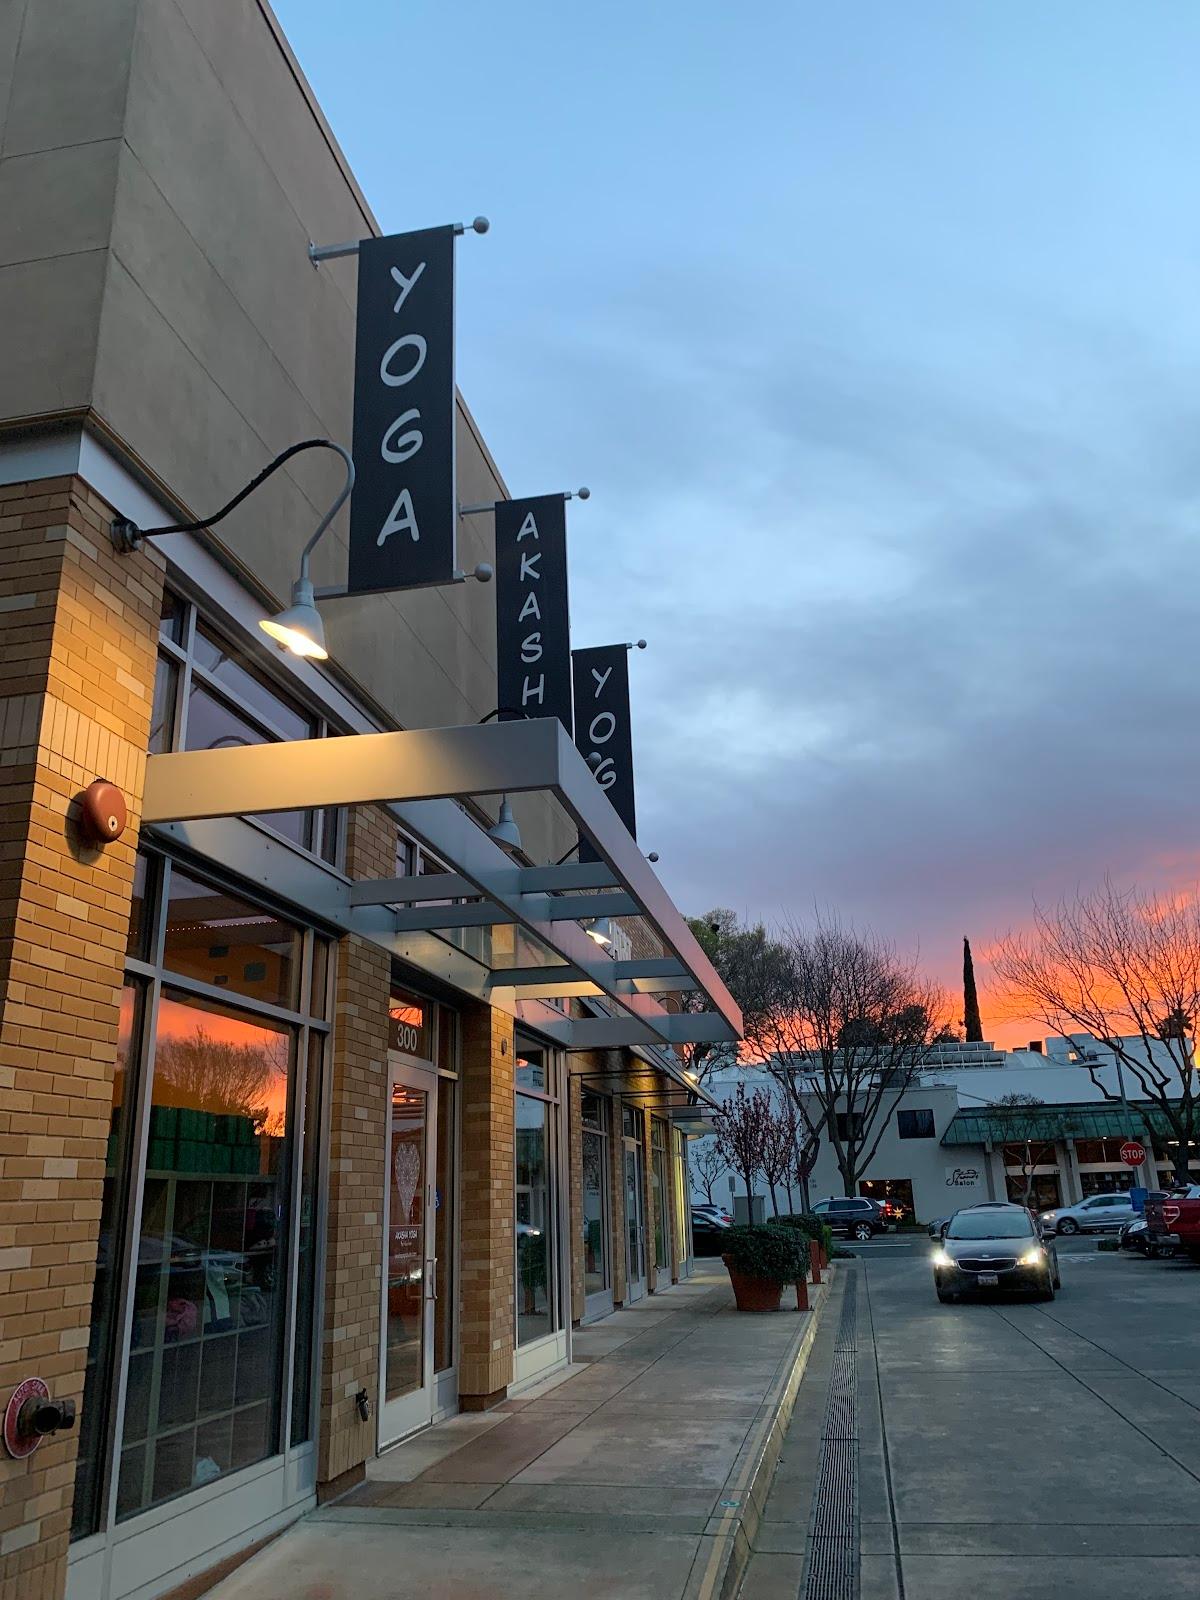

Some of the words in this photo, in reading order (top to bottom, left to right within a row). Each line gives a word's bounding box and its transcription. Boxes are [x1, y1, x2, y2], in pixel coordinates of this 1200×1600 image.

[377, 262, 428, 547] YOGA
[516, 511, 545, 717] AKASH
[589, 666, 617, 791] YOG
[397, 1023, 418, 1051] 300
[1121, 1149, 1145, 1160] STOP
